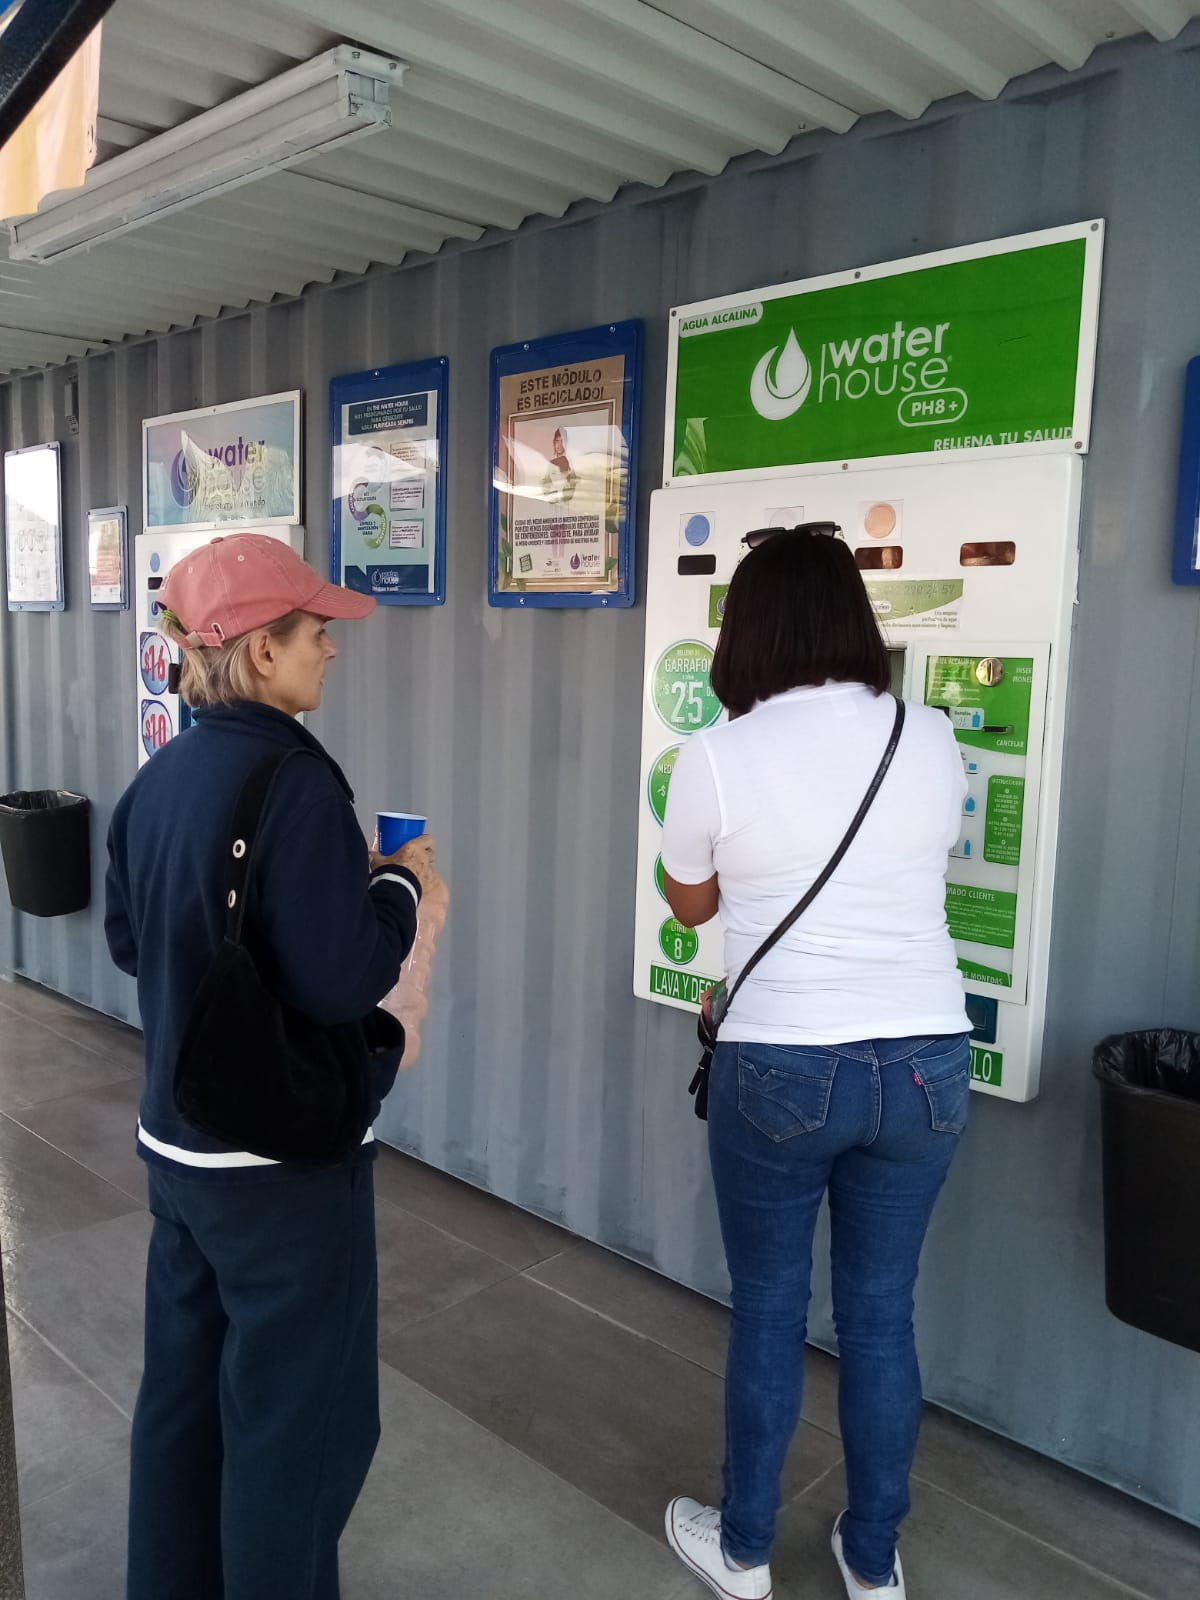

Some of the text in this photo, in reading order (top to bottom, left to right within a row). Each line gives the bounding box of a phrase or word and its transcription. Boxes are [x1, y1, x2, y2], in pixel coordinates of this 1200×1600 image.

[682, 308, 758, 332] AGUA ALCALINA
[828, 321, 951, 369] water
[520, 375, 550, 395] ESTE
[818, 343, 949, 404] house
[517, 386, 604, 411] ES RECICLADO!
[933, 426, 1073, 451] RELLENA TU SALUD
[207, 436, 266, 467] water
[671, 681, 703, 724] 25
[996, 739, 1024, 748] CANCELAR
[968, 890, 996, 902] CLIENTE
[674, 937, 683, 960] 8
[655, 968, 680, 998] LAVA
[682, 975, 689, 1000] Y
